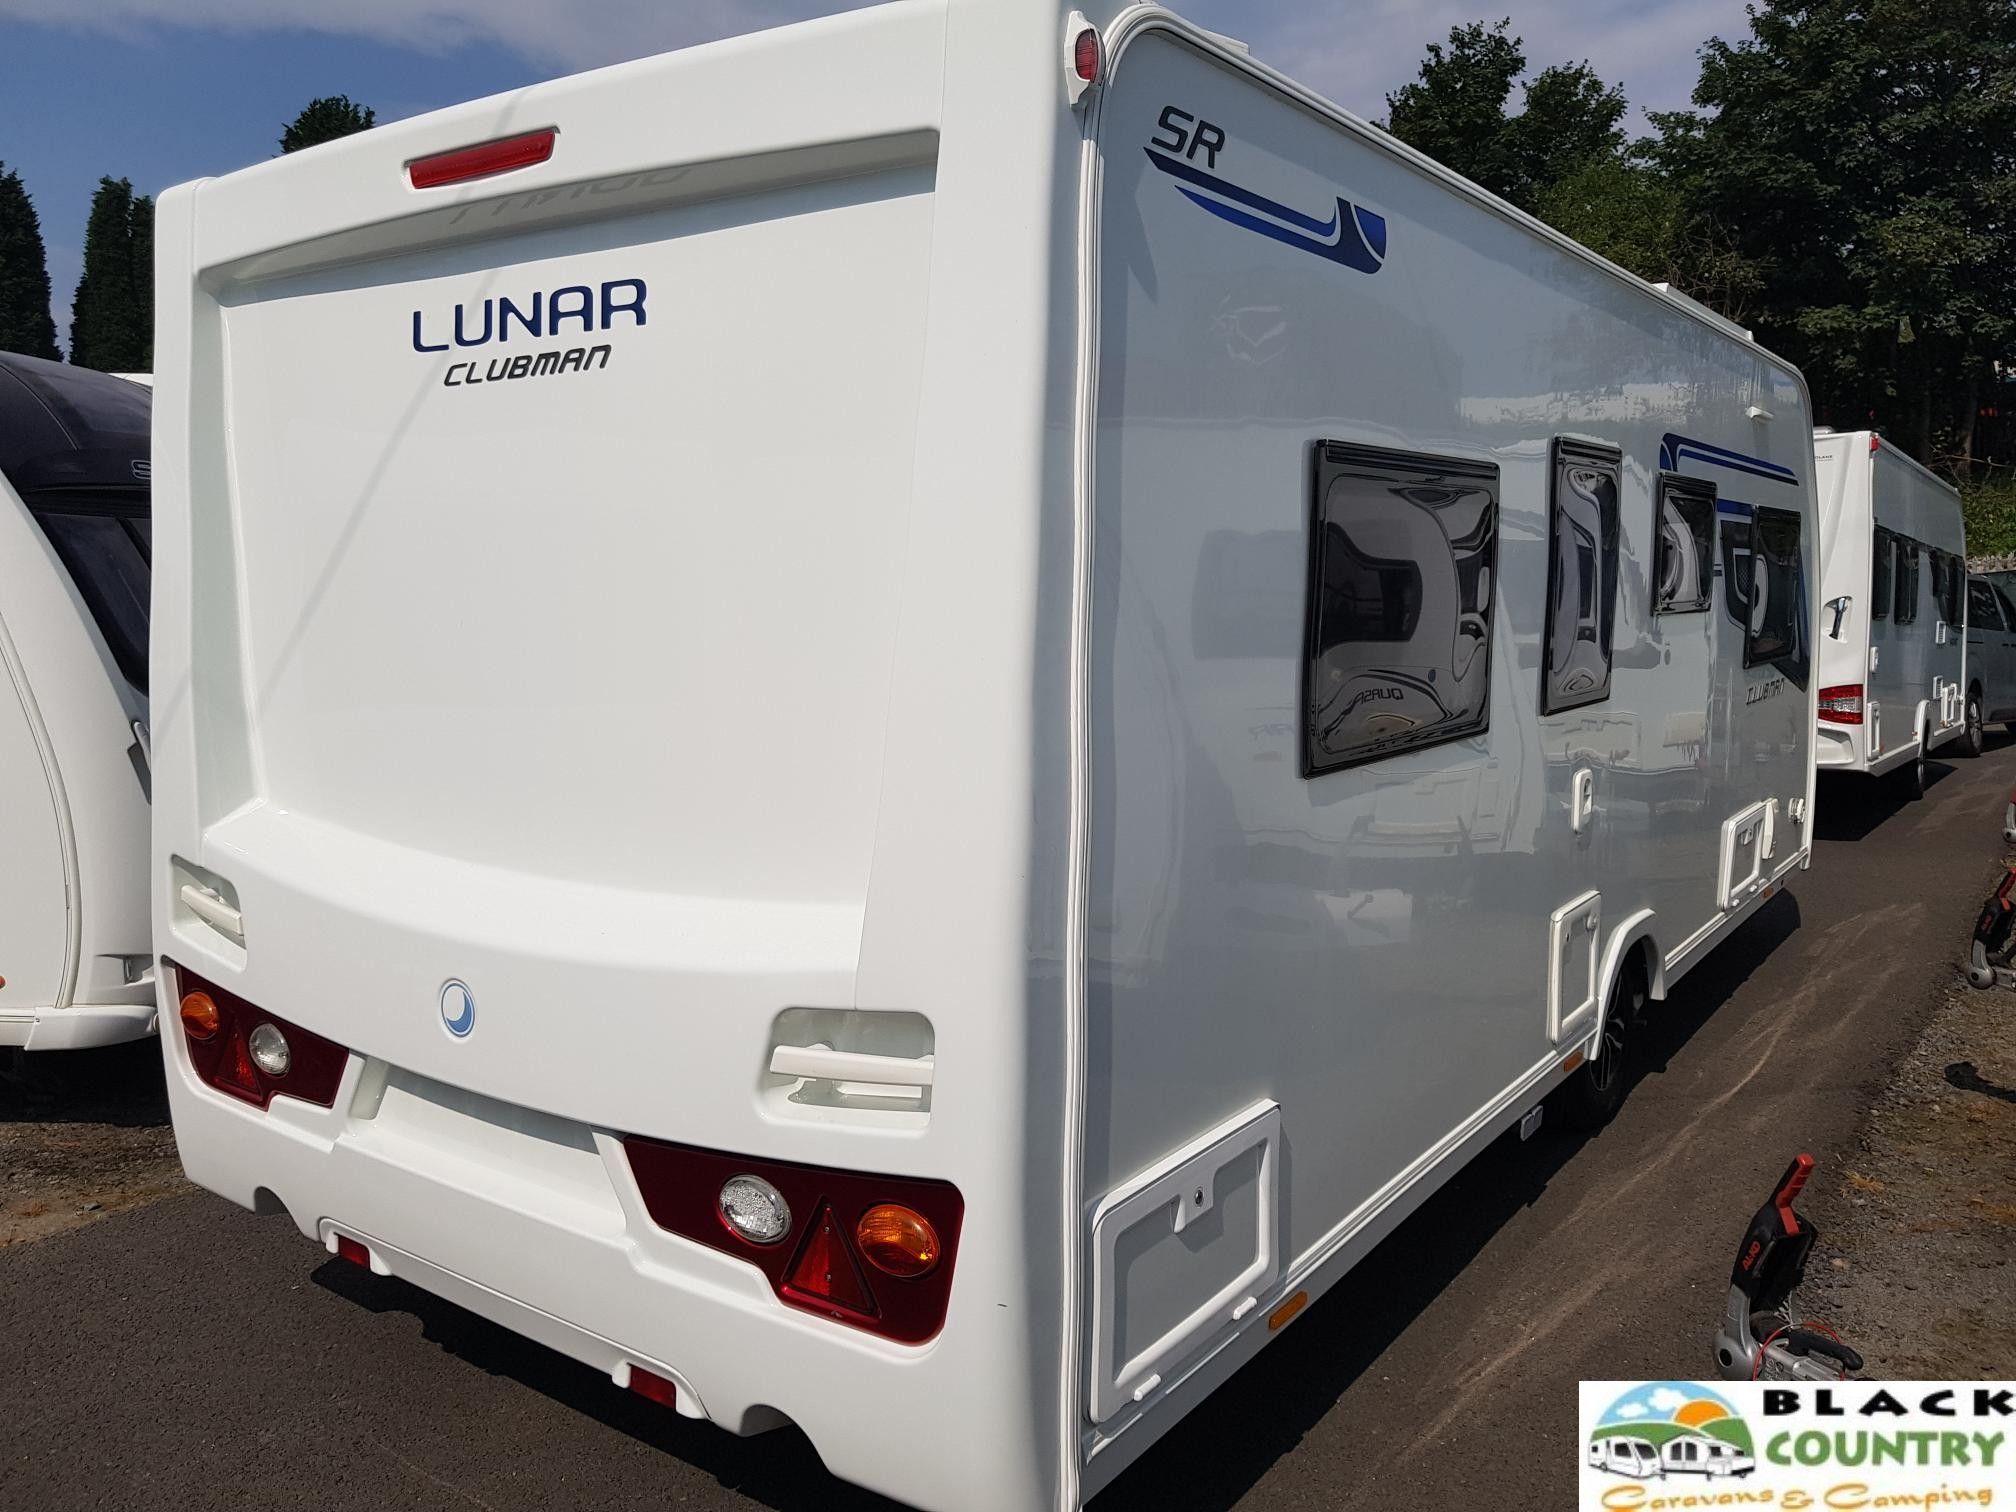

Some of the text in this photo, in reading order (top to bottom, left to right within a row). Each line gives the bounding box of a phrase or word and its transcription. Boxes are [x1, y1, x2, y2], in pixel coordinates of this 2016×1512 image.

[1151, 105, 1226, 169] SR
[412, 278, 647, 353] LUNAR
[443, 344, 612, 387] CLUBMAN
